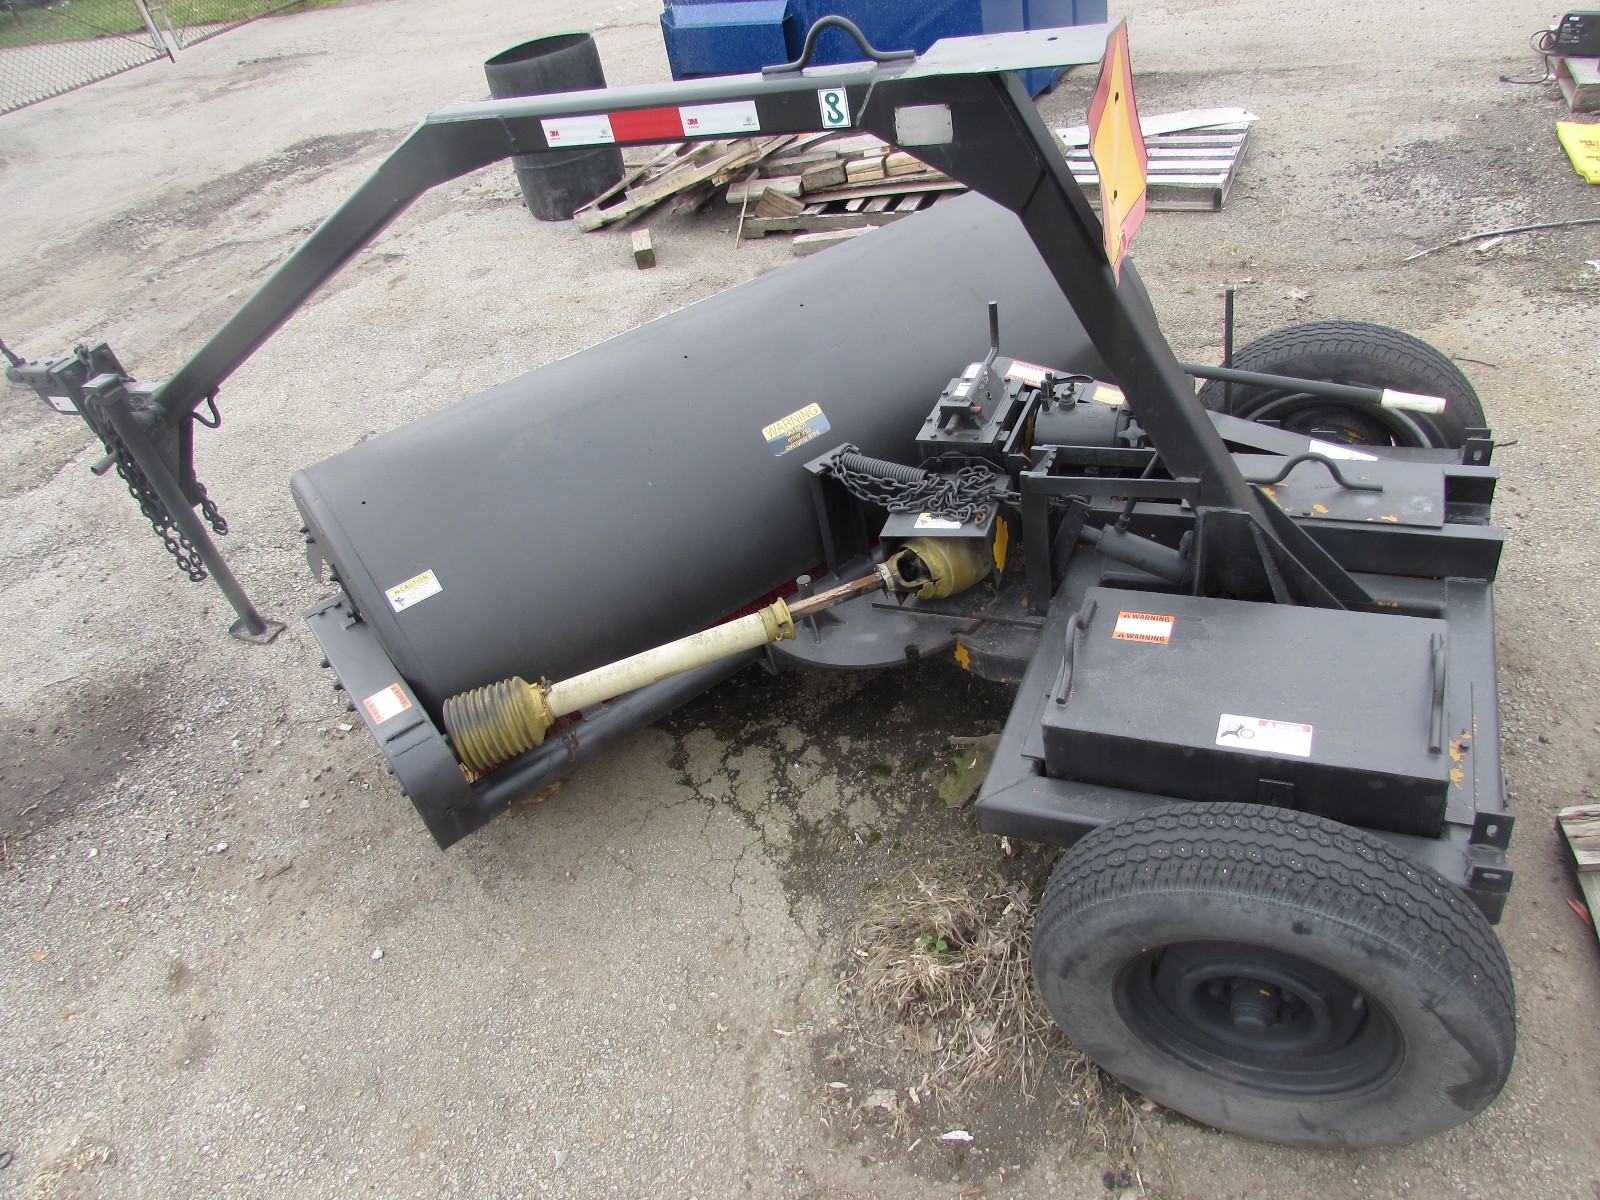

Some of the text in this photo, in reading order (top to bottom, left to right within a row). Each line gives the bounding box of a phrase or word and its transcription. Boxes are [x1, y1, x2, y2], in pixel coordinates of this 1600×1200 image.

[765, 405, 819, 438] WARNING
[785, 422, 808, 437] DO NOT
[399, 575, 428, 592] CAUTION
[1132, 613, 1170, 622] WARNING
[1126, 632, 1165, 642] WARNING
